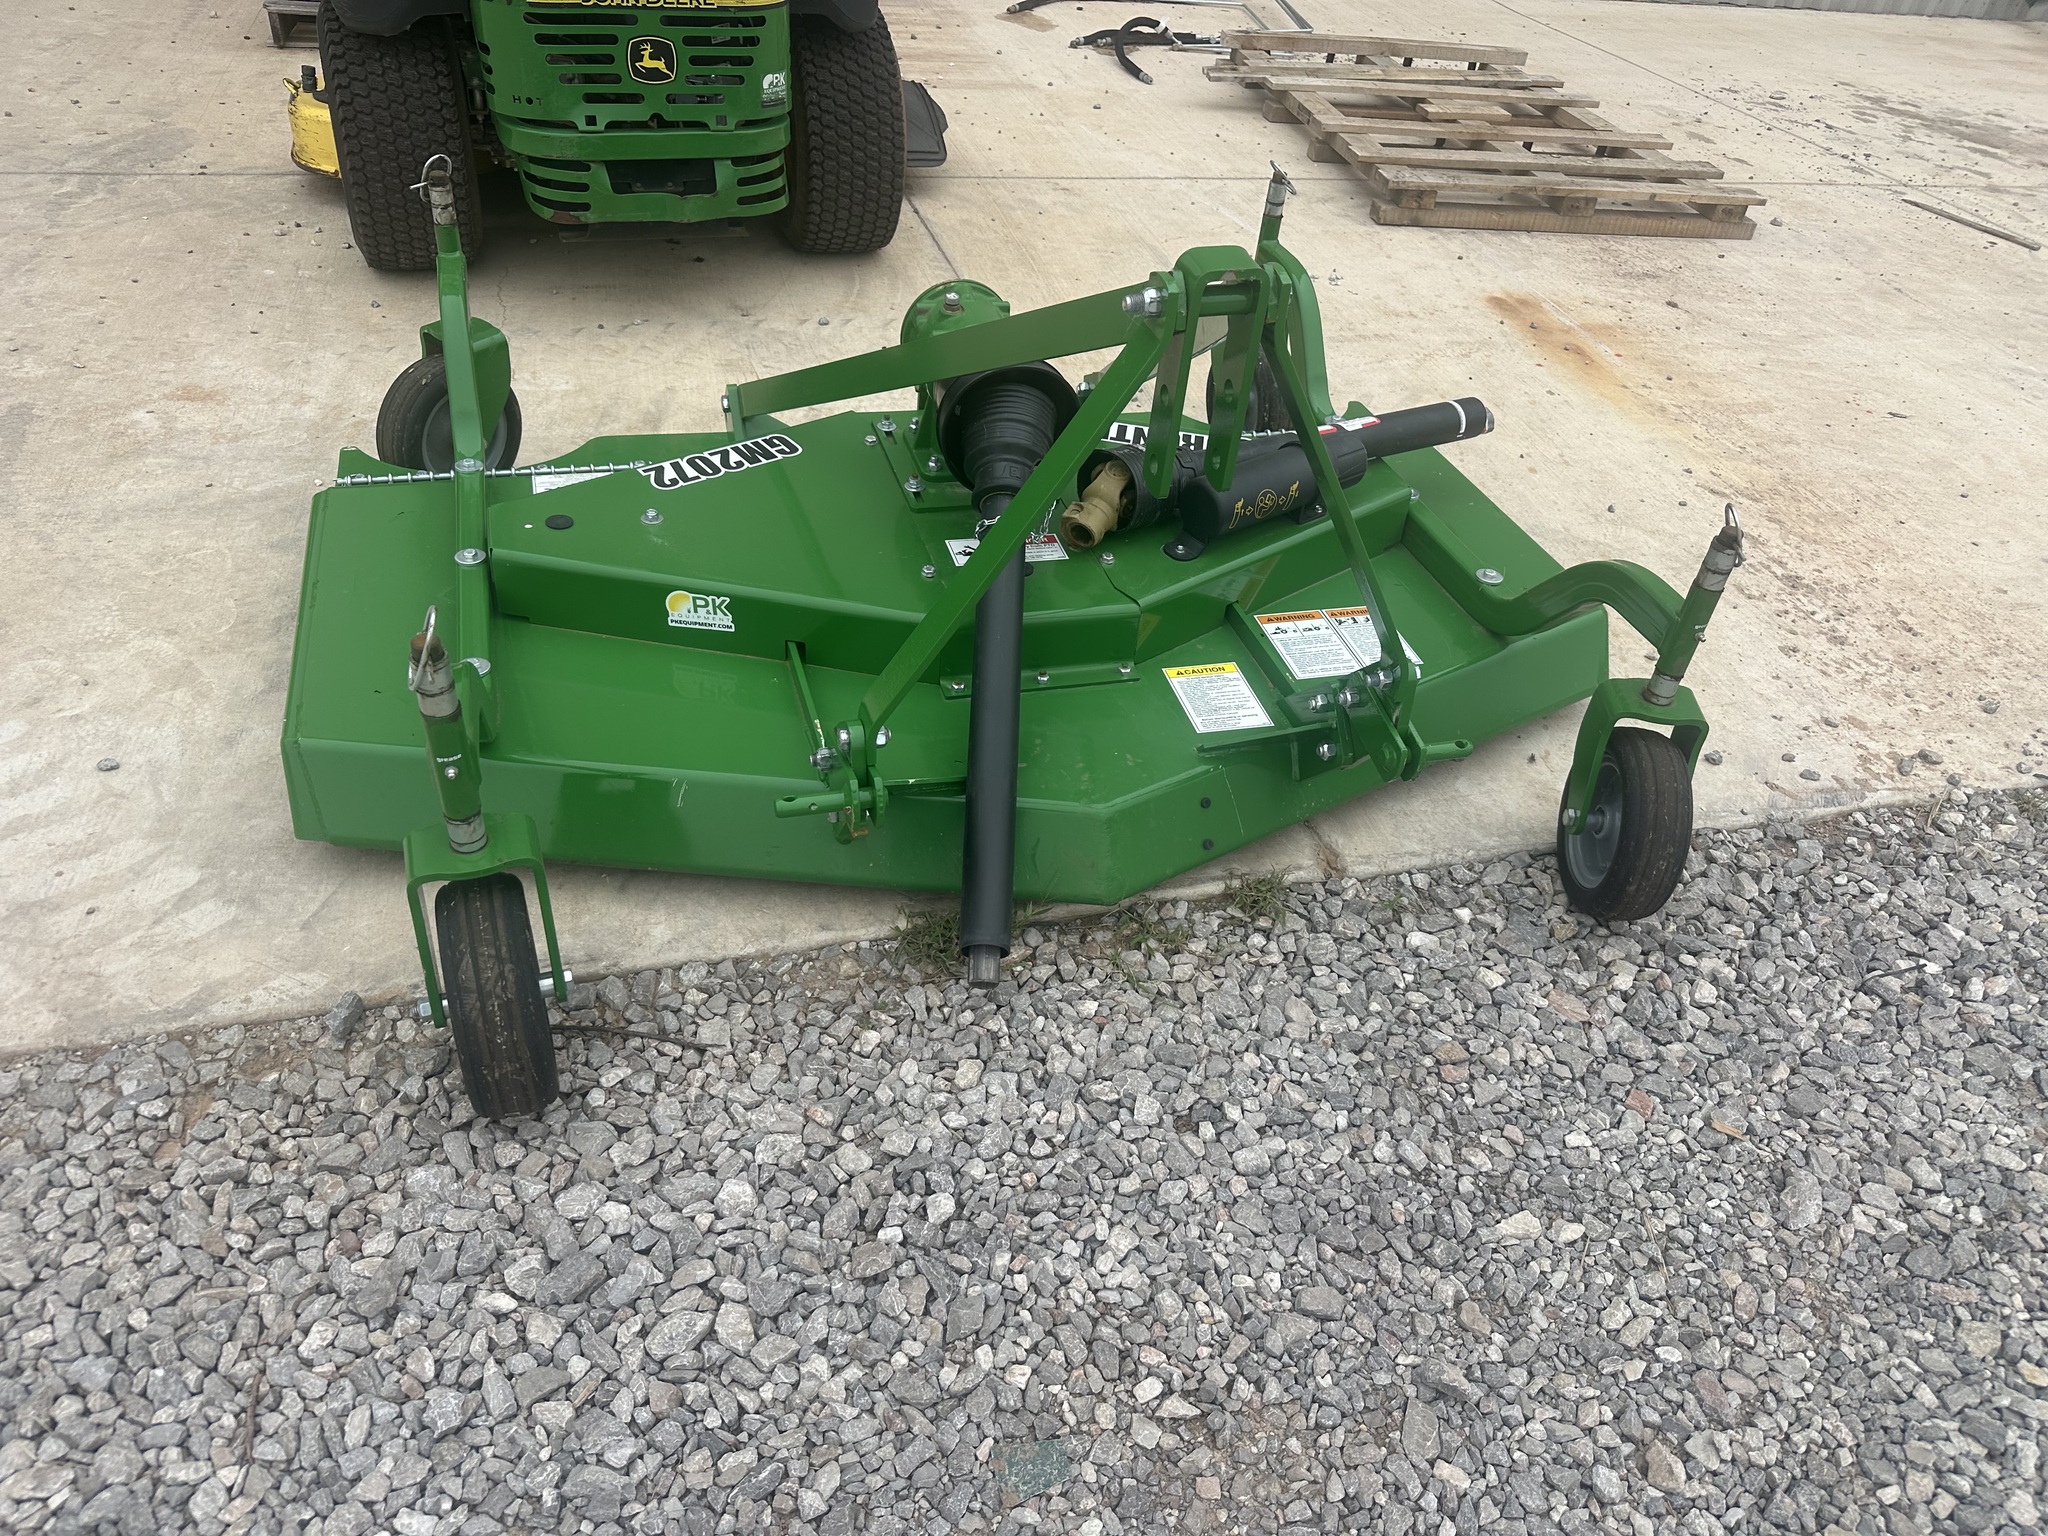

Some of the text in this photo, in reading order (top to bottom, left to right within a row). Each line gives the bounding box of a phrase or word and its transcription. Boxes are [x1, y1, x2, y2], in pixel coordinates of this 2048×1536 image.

[641, 435, 801, 489] GM2072
[671, 612, 730, 623] EQUIPMENT
[1273, 613, 1316, 622] WARNING
[670, 618, 733, 630] PKEQUIPMENT.COM
[1184, 666, 1226, 675] CAUTION
